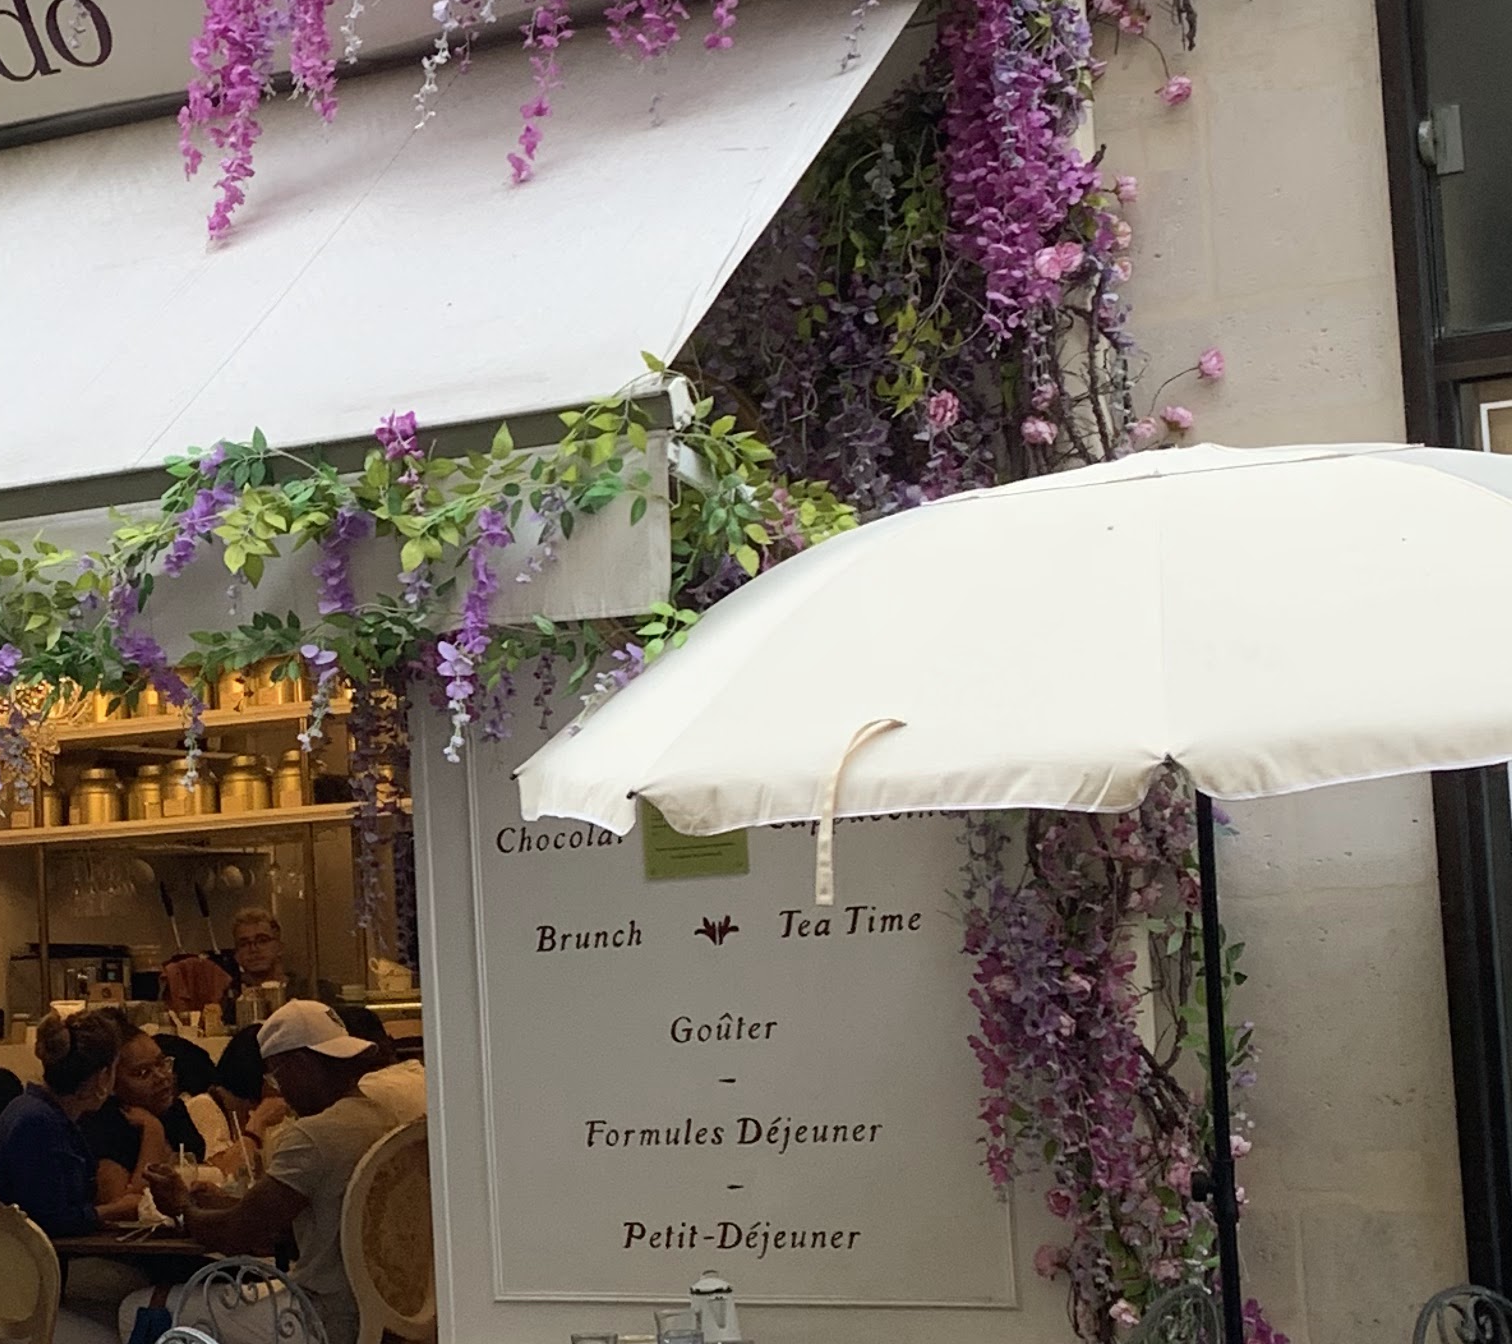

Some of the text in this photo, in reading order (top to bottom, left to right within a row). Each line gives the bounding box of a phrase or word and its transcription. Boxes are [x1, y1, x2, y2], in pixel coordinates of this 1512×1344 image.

[536, 920, 643, 952] Brunch
[779, 906, 922, 939] Tea Time
[670, 1012, 778, 1044] Goûter
[585, 1117, 883, 1155] Formules Déjeuner
[622, 1221, 862, 1259] Petit-Déjeuner
